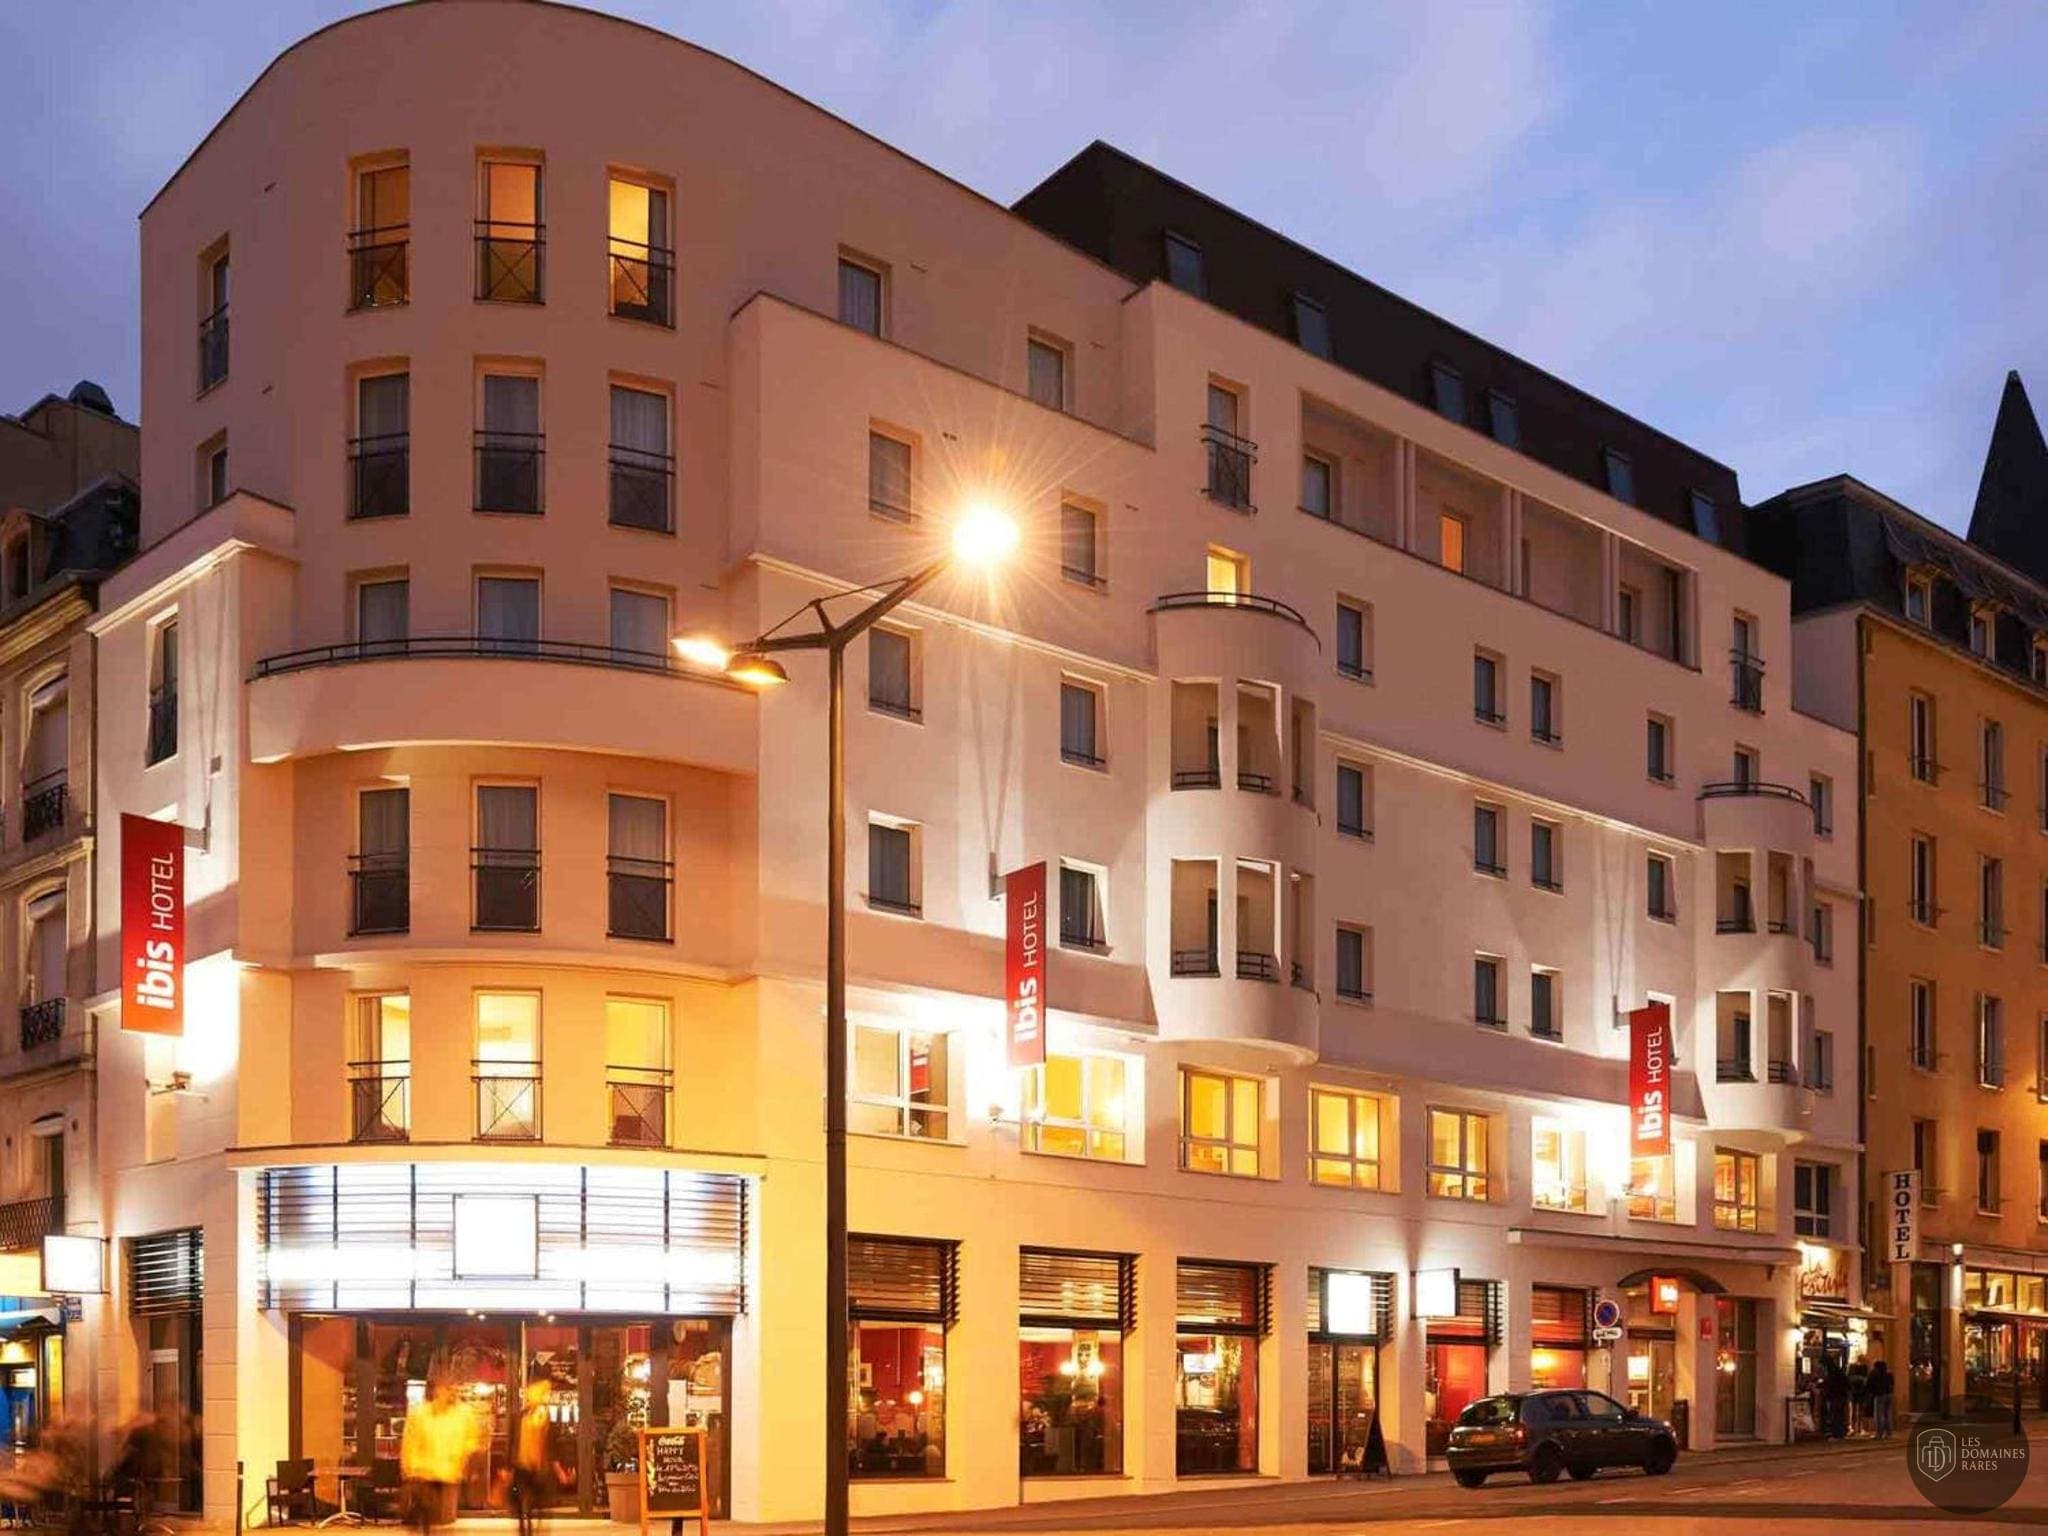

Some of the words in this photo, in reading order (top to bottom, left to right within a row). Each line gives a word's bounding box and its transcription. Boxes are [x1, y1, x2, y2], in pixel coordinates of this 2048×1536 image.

[151, 852, 175, 931] HOTEL
[1023, 890, 1038, 968] HOTEL
[136, 940, 175, 1010] ibis
[1014, 976, 1038, 1043] ibis
[1647, 1026, 1663, 1084] HOTEL
[1637, 1089, 1663, 1140] ibis
[1894, 1173, 1910, 1260] HOTEL
